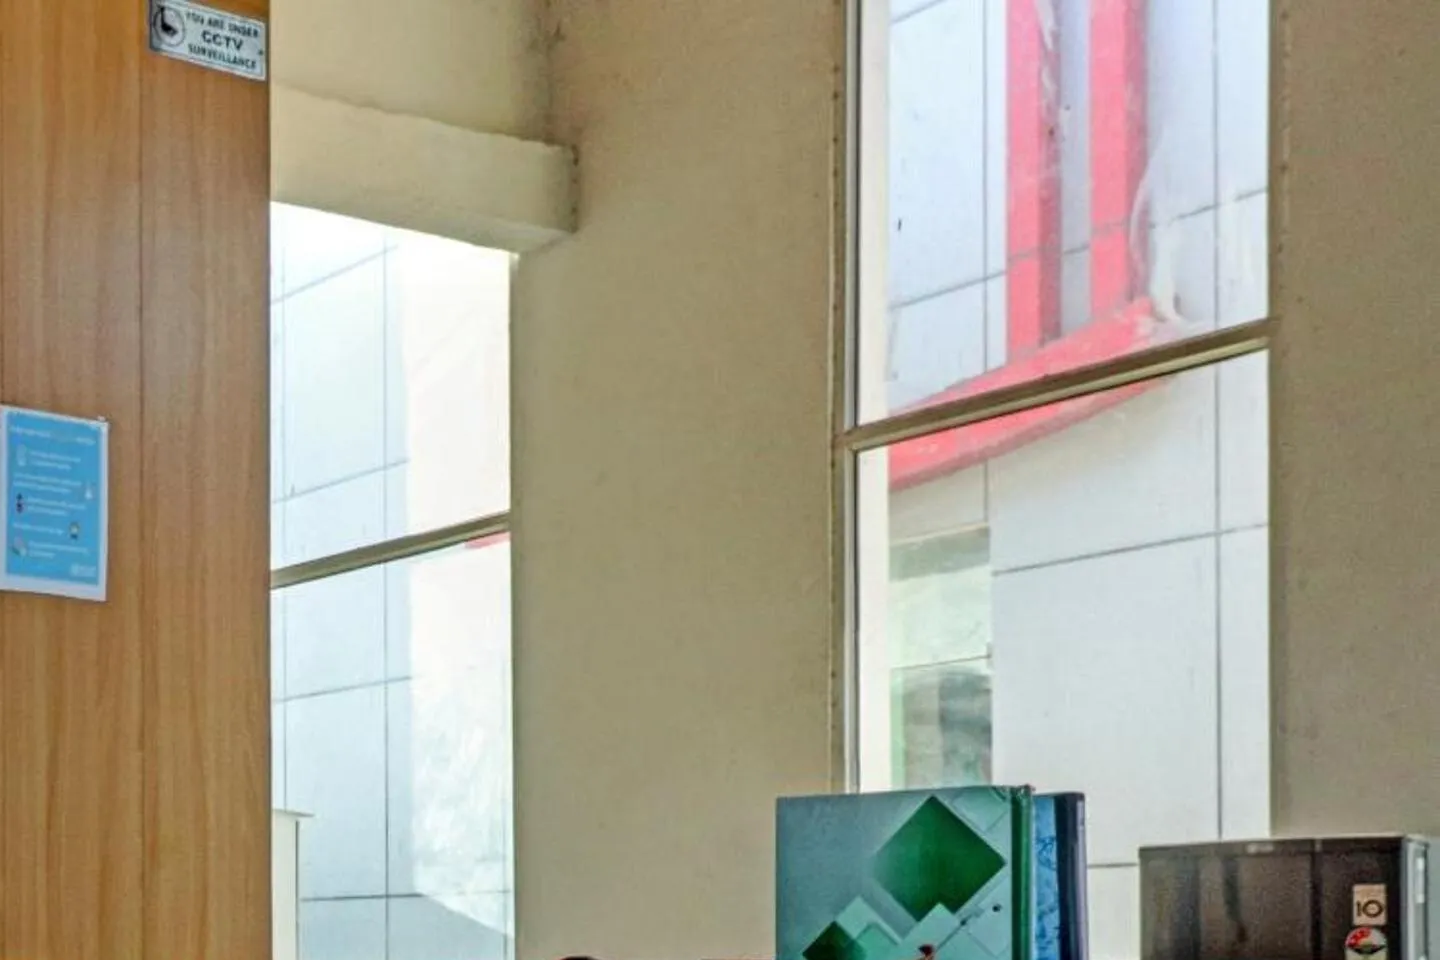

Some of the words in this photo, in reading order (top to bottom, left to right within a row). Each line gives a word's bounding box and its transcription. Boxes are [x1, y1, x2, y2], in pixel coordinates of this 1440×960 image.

[207, 17, 224, 29] ARE
[228, 22, 259, 38] UNDER
[201, 29, 244, 50] CCTV
[187, 43, 257, 69] SURVEILLANCE
